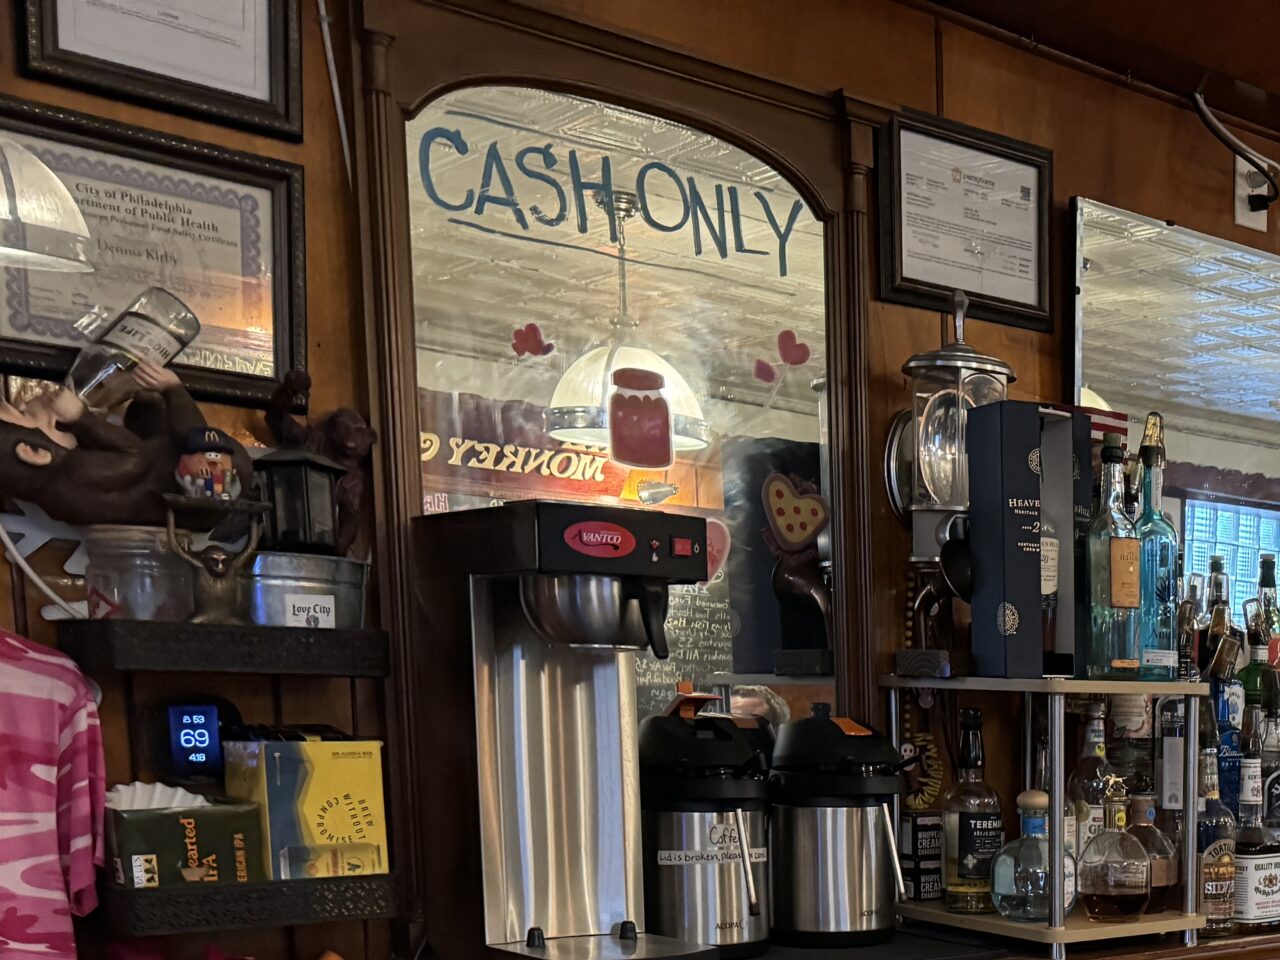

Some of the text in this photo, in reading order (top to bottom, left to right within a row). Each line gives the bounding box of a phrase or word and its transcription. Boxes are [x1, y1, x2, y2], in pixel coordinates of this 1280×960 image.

[75, 182, 106, 199] City
[105, 187, 118, 200] of
[121, 191, 193, 216] Philadelphia
[419, 127, 803, 278] CASH ONLY
[75, 198, 121, 213] artment
[124, 205, 137, 217] of
[140, 209, 176, 225] Public
[181, 217, 219, 233] Health
[97, 239, 178, 266] Dennis Kirby
[572, 529, 622, 550] AVANTCO
[292, 603, 331, 617] Love City
[180, 729, 210, 747] 69
[315, 796, 354, 844] COMPROMISE
[342, 793, 366, 840] WITHOUT
[357, 799, 375, 827] BREW
[709, 825, 741, 845] Coffe
[659, 850, 744, 863] Lid is broken, pleas
[1254, 862, 1273, 871] QUALITY
